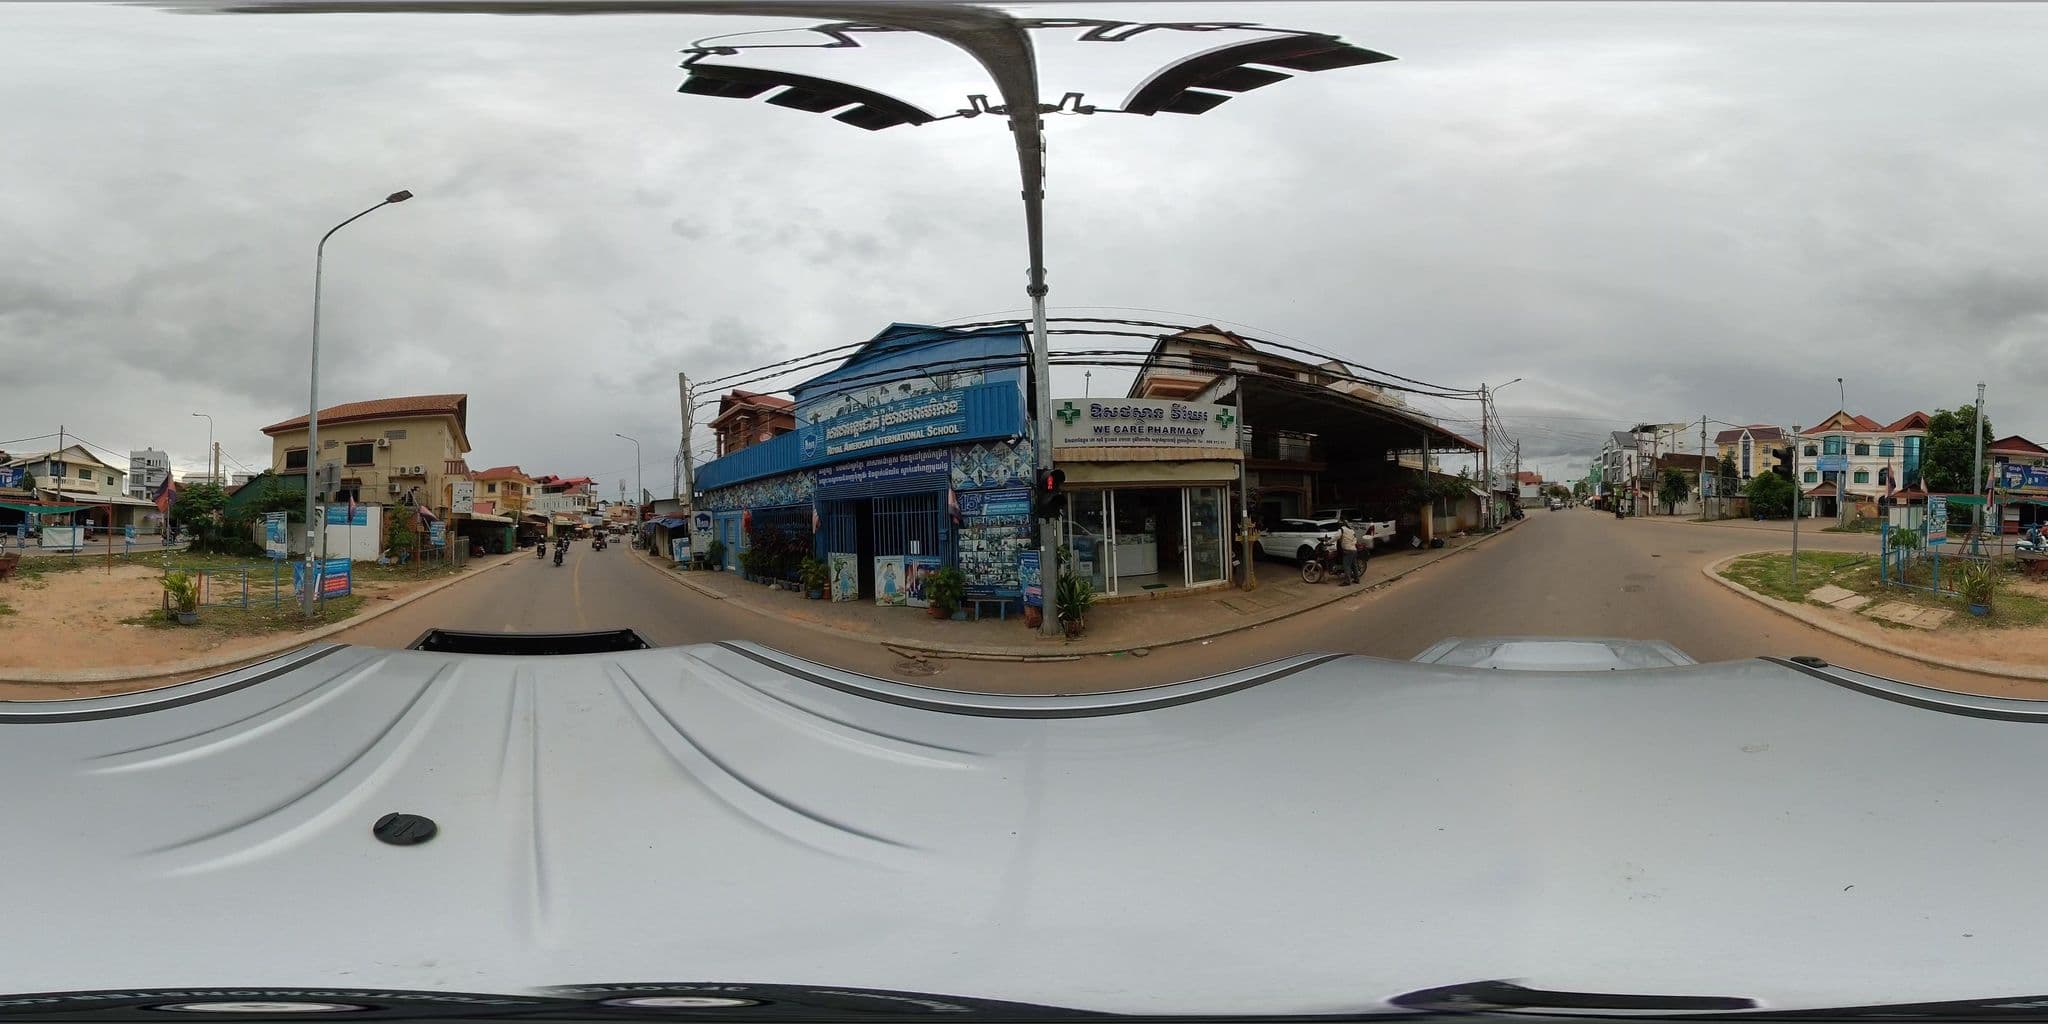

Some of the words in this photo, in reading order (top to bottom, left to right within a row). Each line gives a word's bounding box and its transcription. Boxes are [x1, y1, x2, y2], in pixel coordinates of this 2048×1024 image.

[1093, 425, 1111, 434] WE
[1113, 425, 1145, 434] CARE
[1147, 426, 1206, 436] PHARMACY
